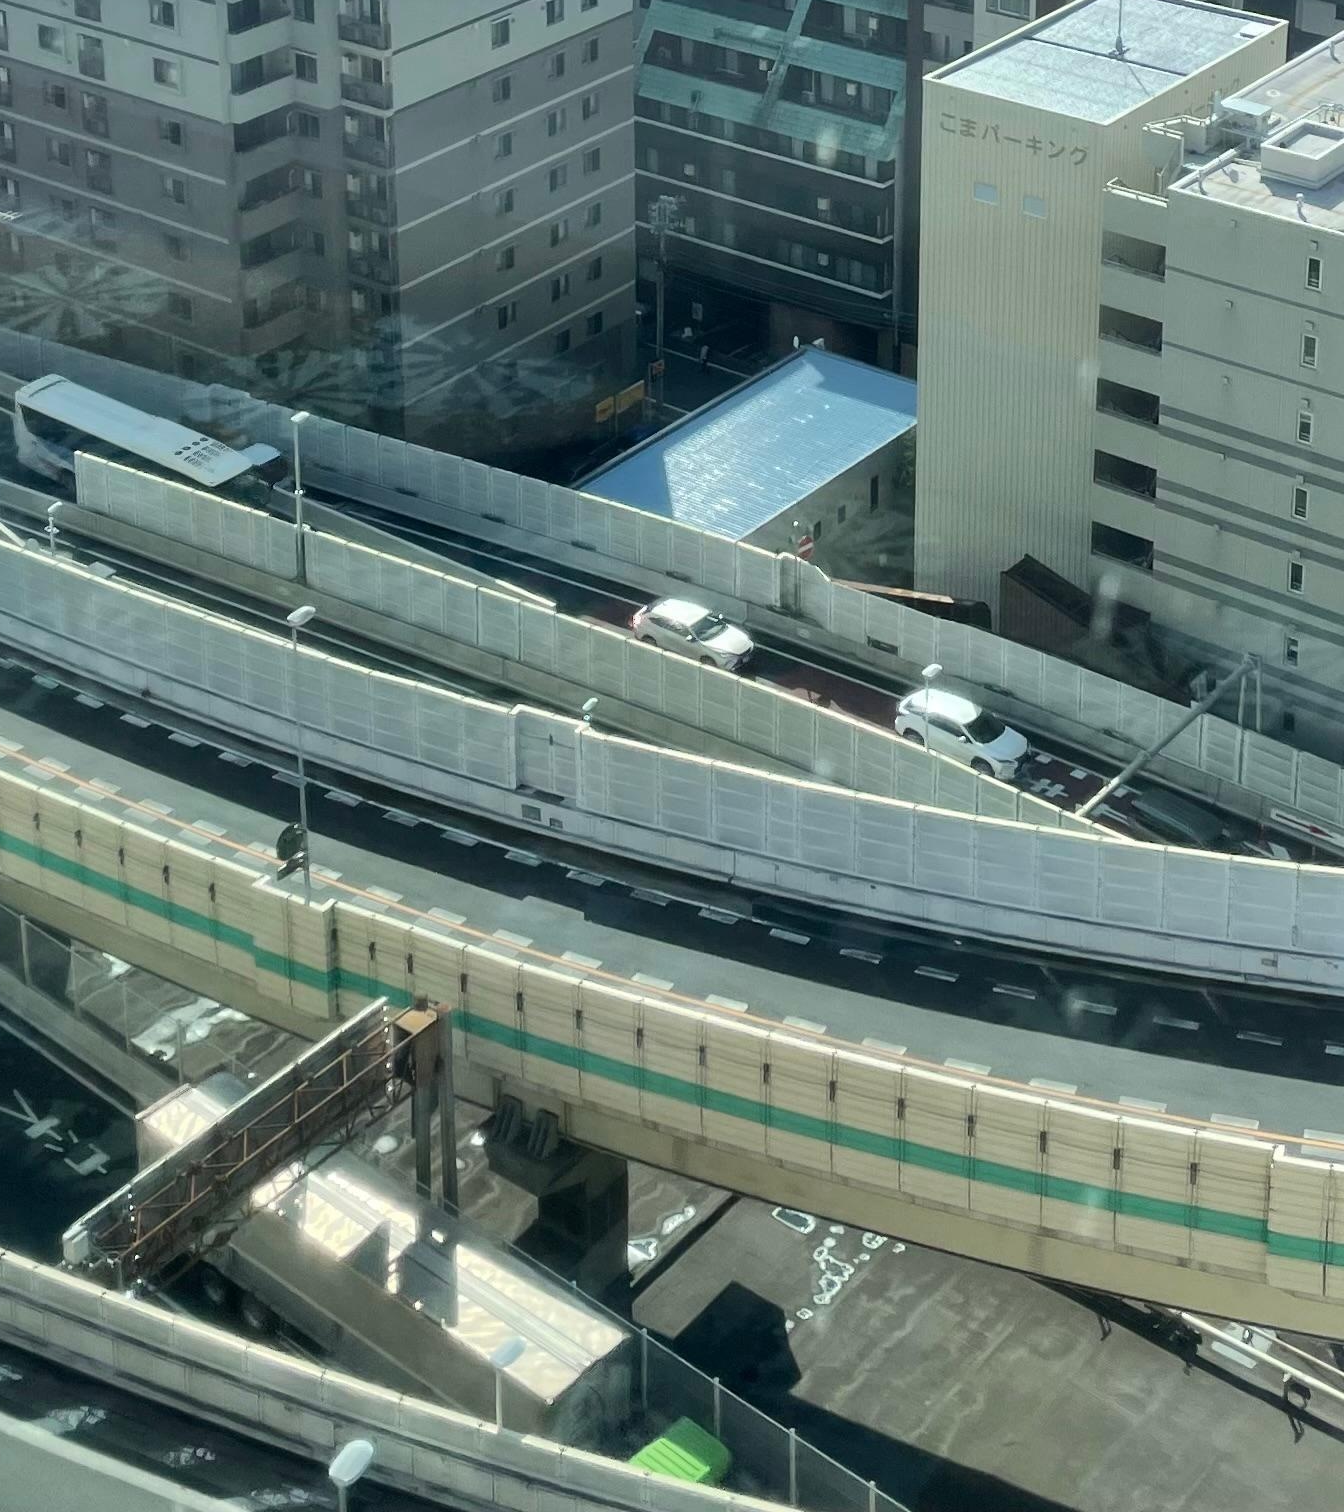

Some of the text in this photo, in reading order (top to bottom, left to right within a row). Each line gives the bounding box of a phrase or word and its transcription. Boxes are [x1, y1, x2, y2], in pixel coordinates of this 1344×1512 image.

[940, 112, 1088, 165] こまパーキング
